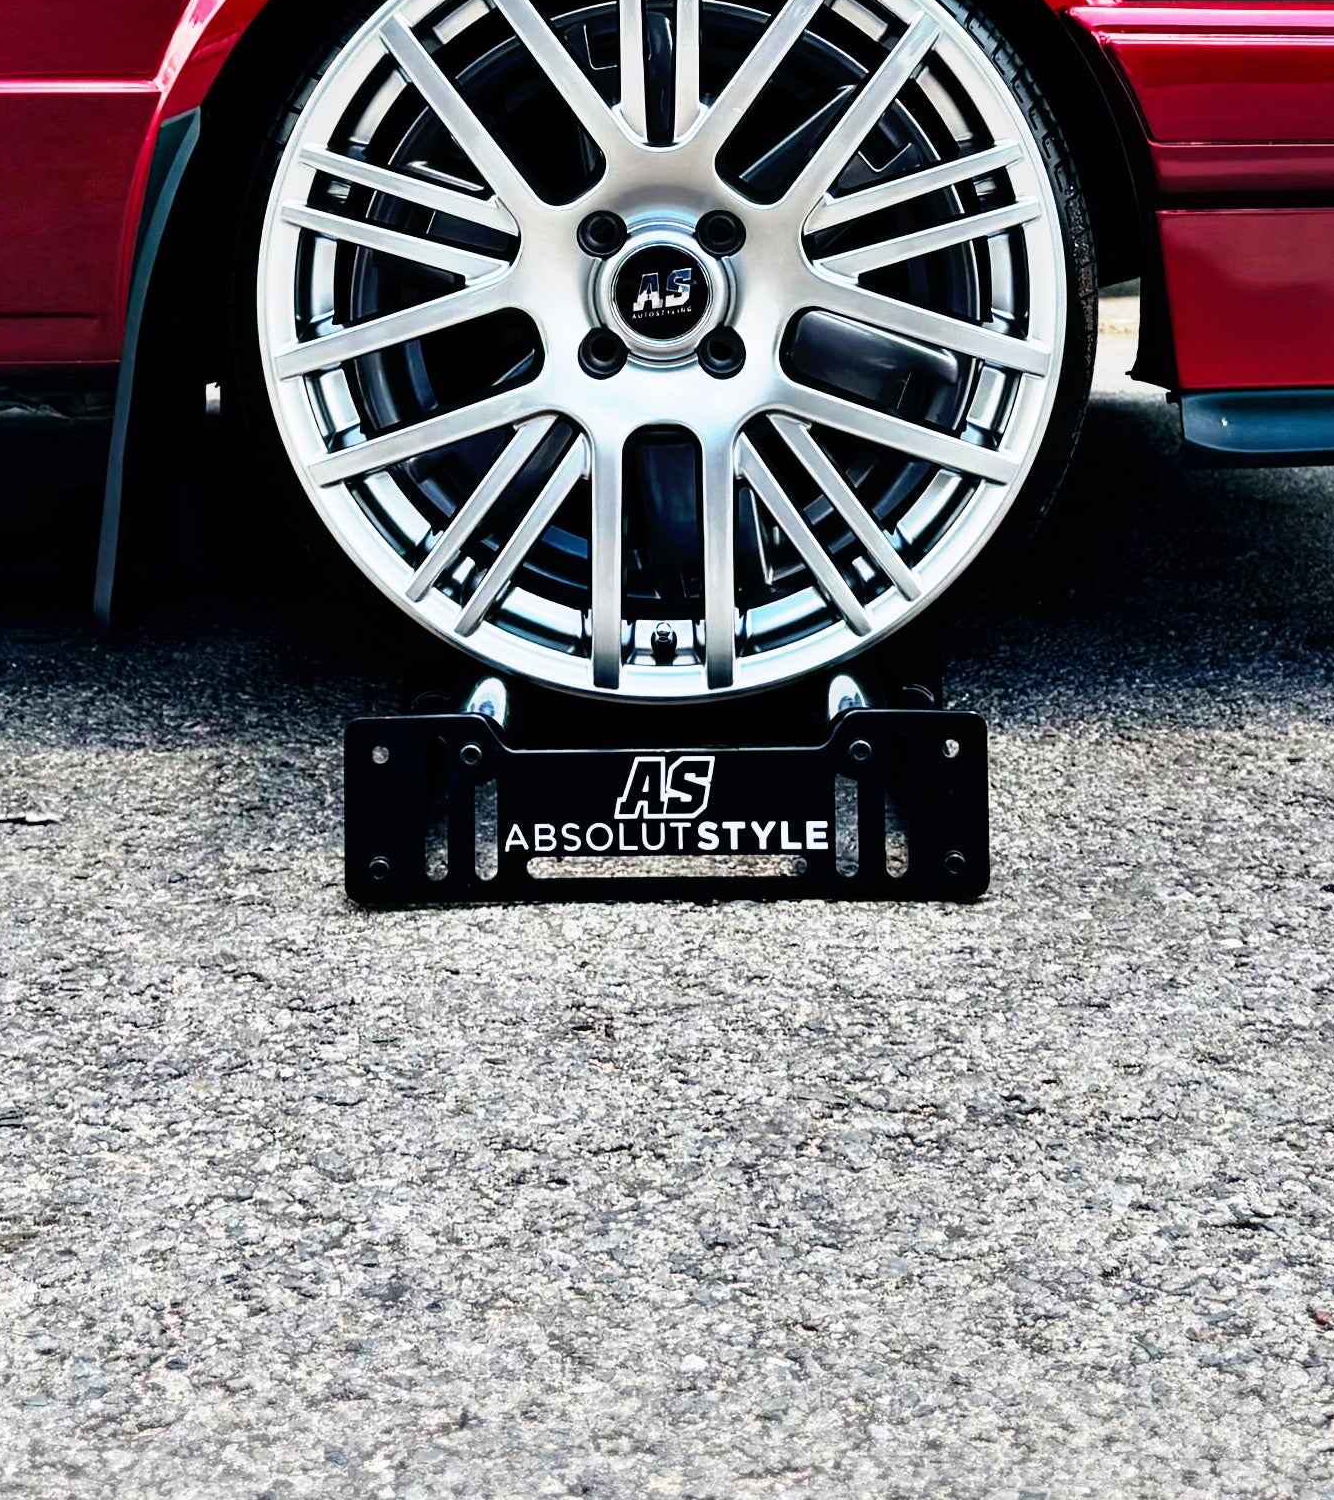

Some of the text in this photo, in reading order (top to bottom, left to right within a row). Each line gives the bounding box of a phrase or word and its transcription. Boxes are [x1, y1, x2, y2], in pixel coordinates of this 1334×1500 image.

[632, 267, 693, 312] AS
[614, 755, 716, 820] AS
[504, 820, 829, 853] ABSOLUTSTYLE
